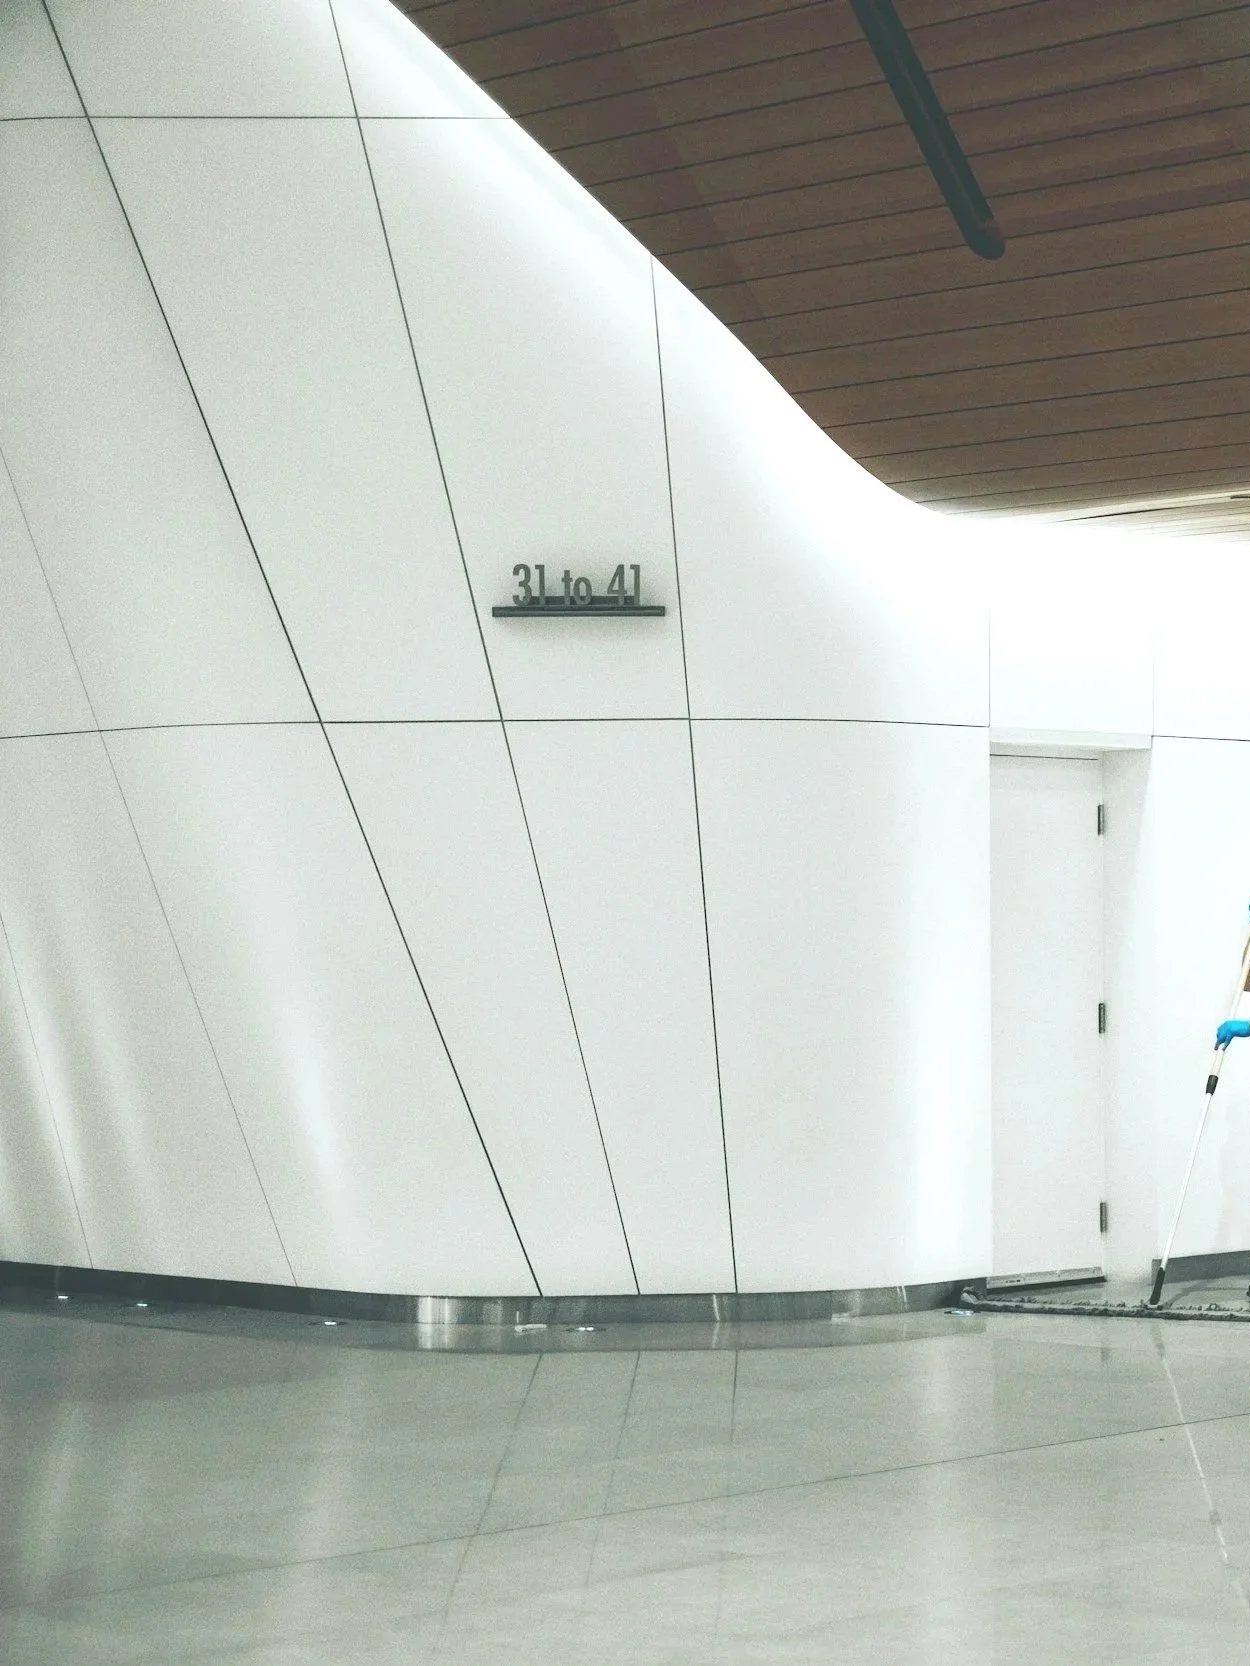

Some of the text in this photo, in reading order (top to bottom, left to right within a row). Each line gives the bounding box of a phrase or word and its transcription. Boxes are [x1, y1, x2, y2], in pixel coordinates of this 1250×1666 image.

[512, 563, 641, 607] 31 to 41
